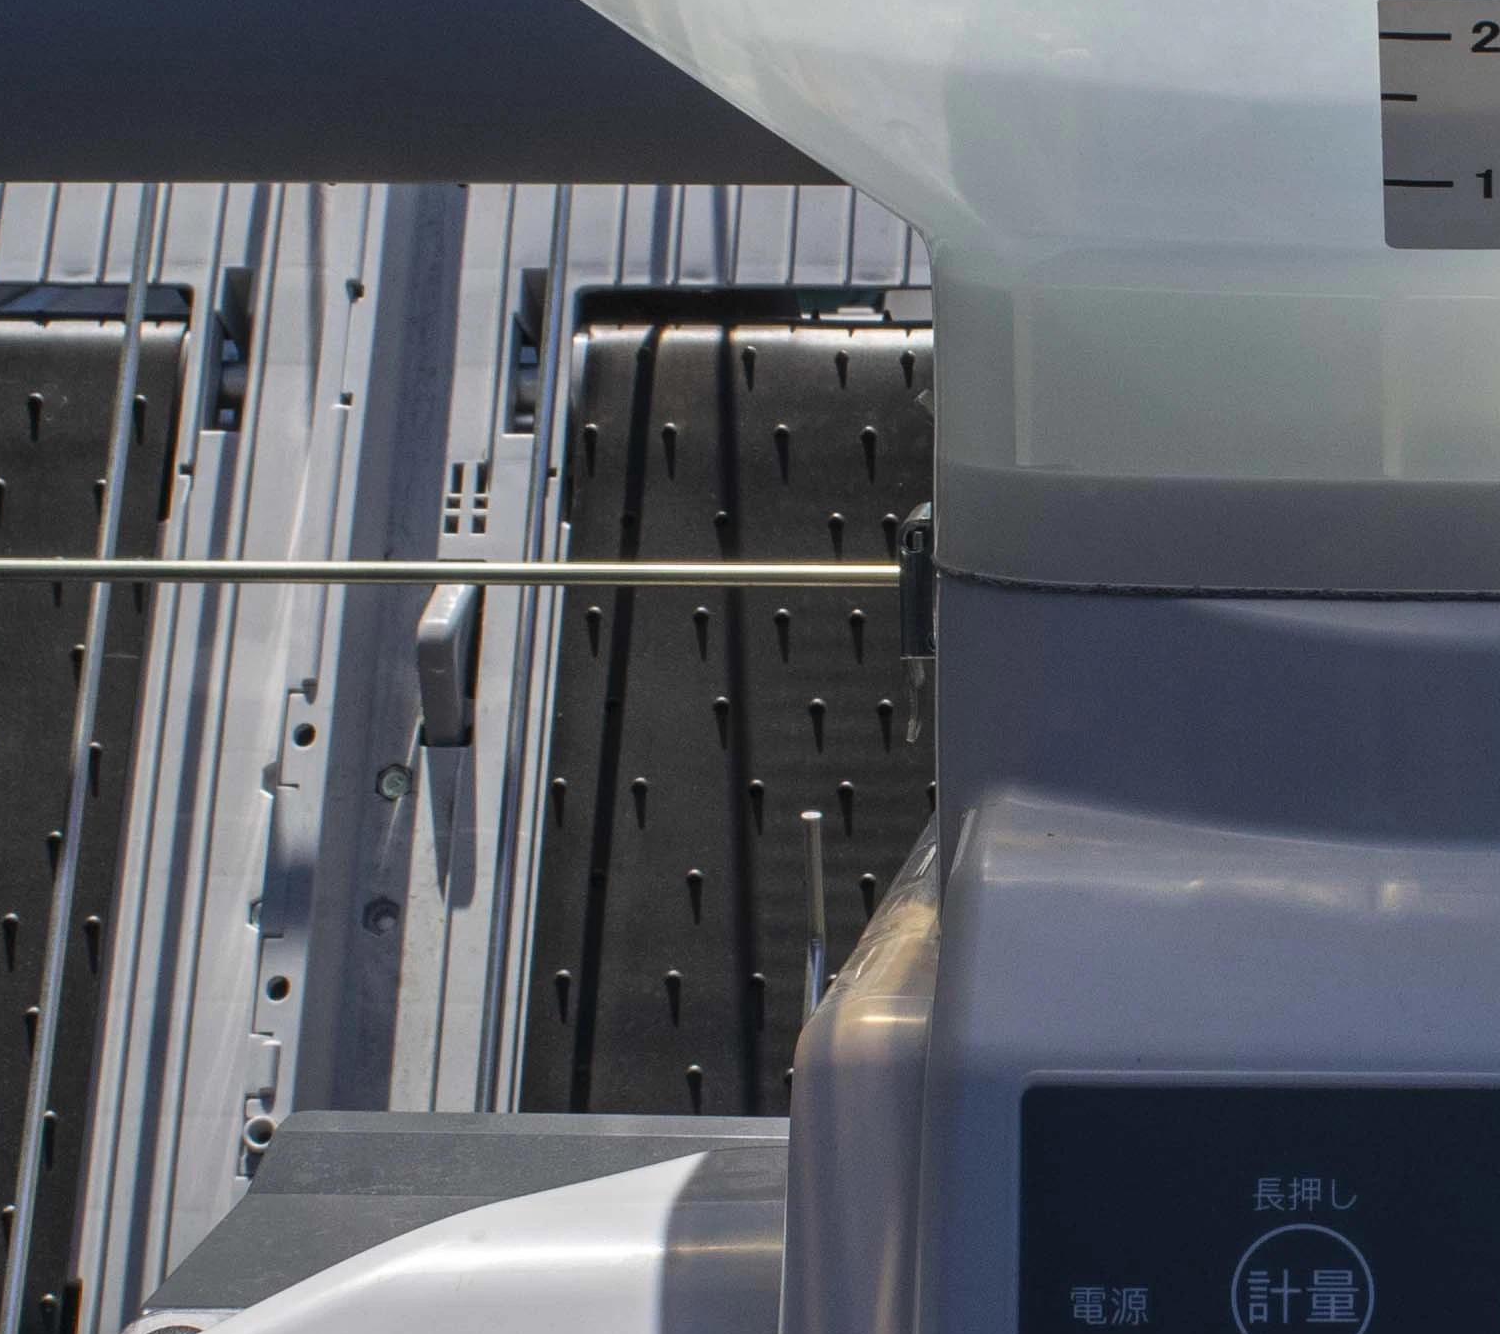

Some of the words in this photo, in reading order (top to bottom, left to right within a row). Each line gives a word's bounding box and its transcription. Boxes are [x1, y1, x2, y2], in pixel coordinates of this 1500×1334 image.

[1471, 21, 1500, 53] 2
[1475, 169, 1493, 199] 1
[1253, 1177, 1358, 1211] 長押し
[1070, 1286, 1149, 1325] 電源
[1248, 1269, 1361, 1326] 計量
